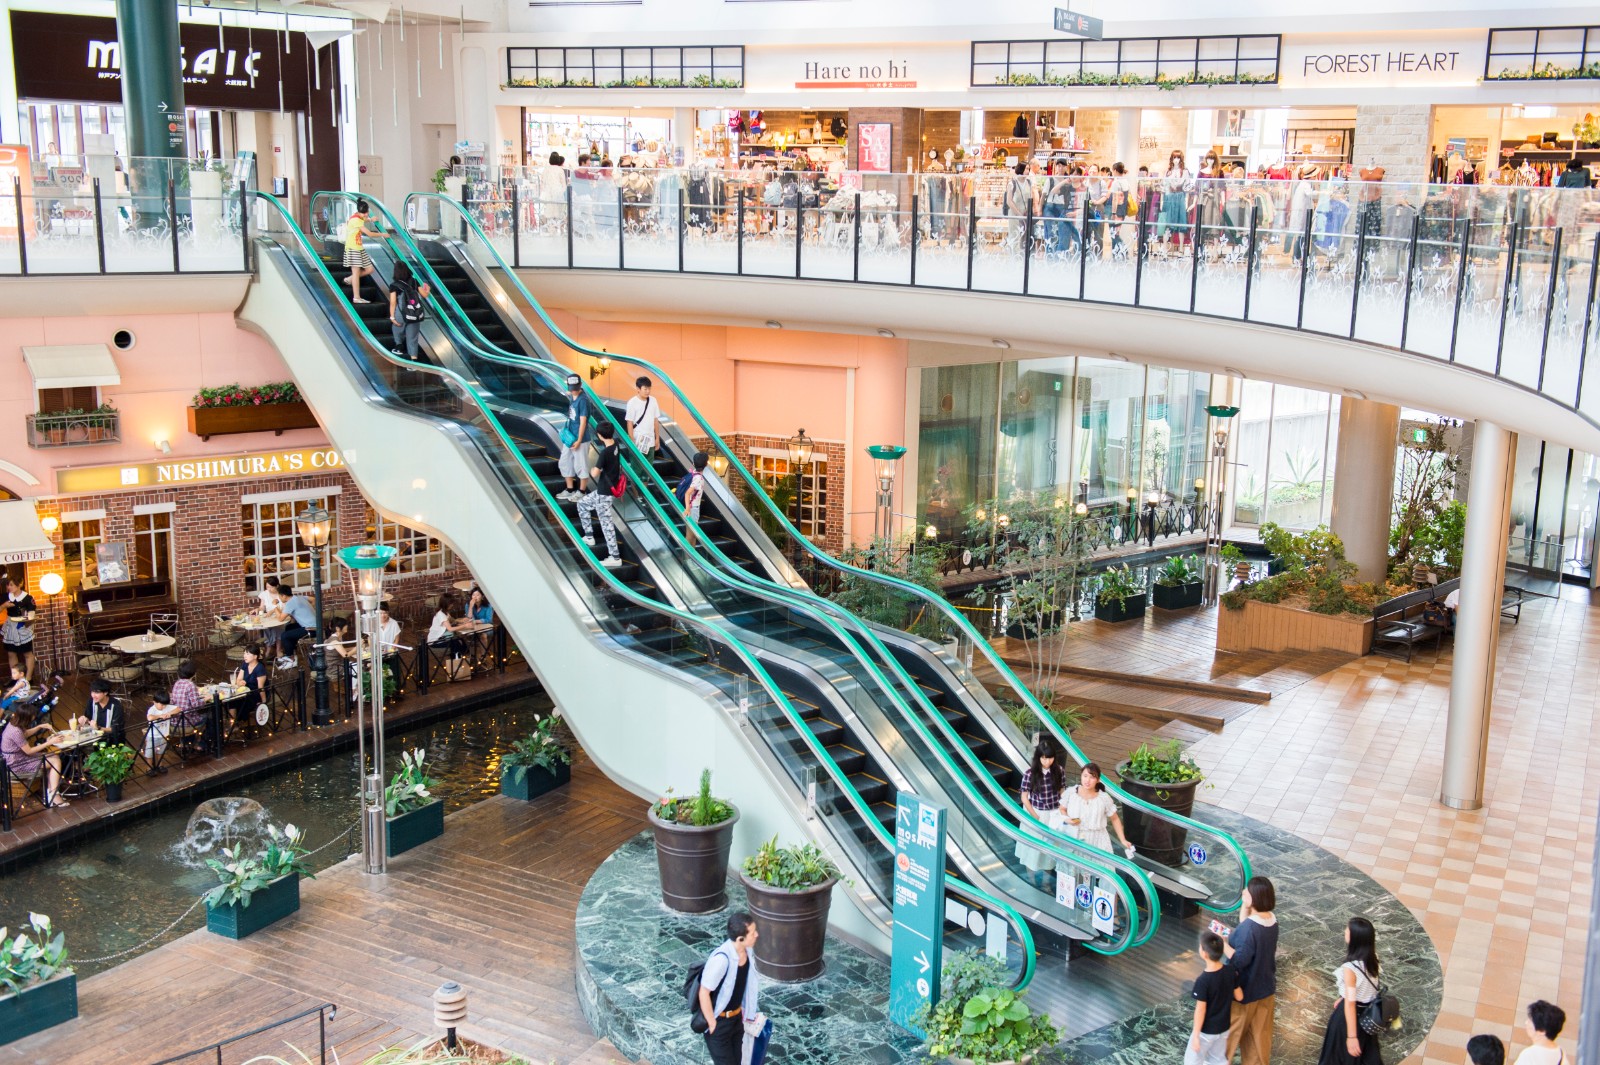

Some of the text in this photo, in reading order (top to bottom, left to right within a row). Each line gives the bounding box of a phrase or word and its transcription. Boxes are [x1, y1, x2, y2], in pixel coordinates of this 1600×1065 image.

[804, 60, 907, 80] Hare no hi
[1303, 52, 1459, 77] FOREST HEART
[156, 453, 304, 482] NISHIMURA'S
[4, 550, 46, 563] COFFEE
